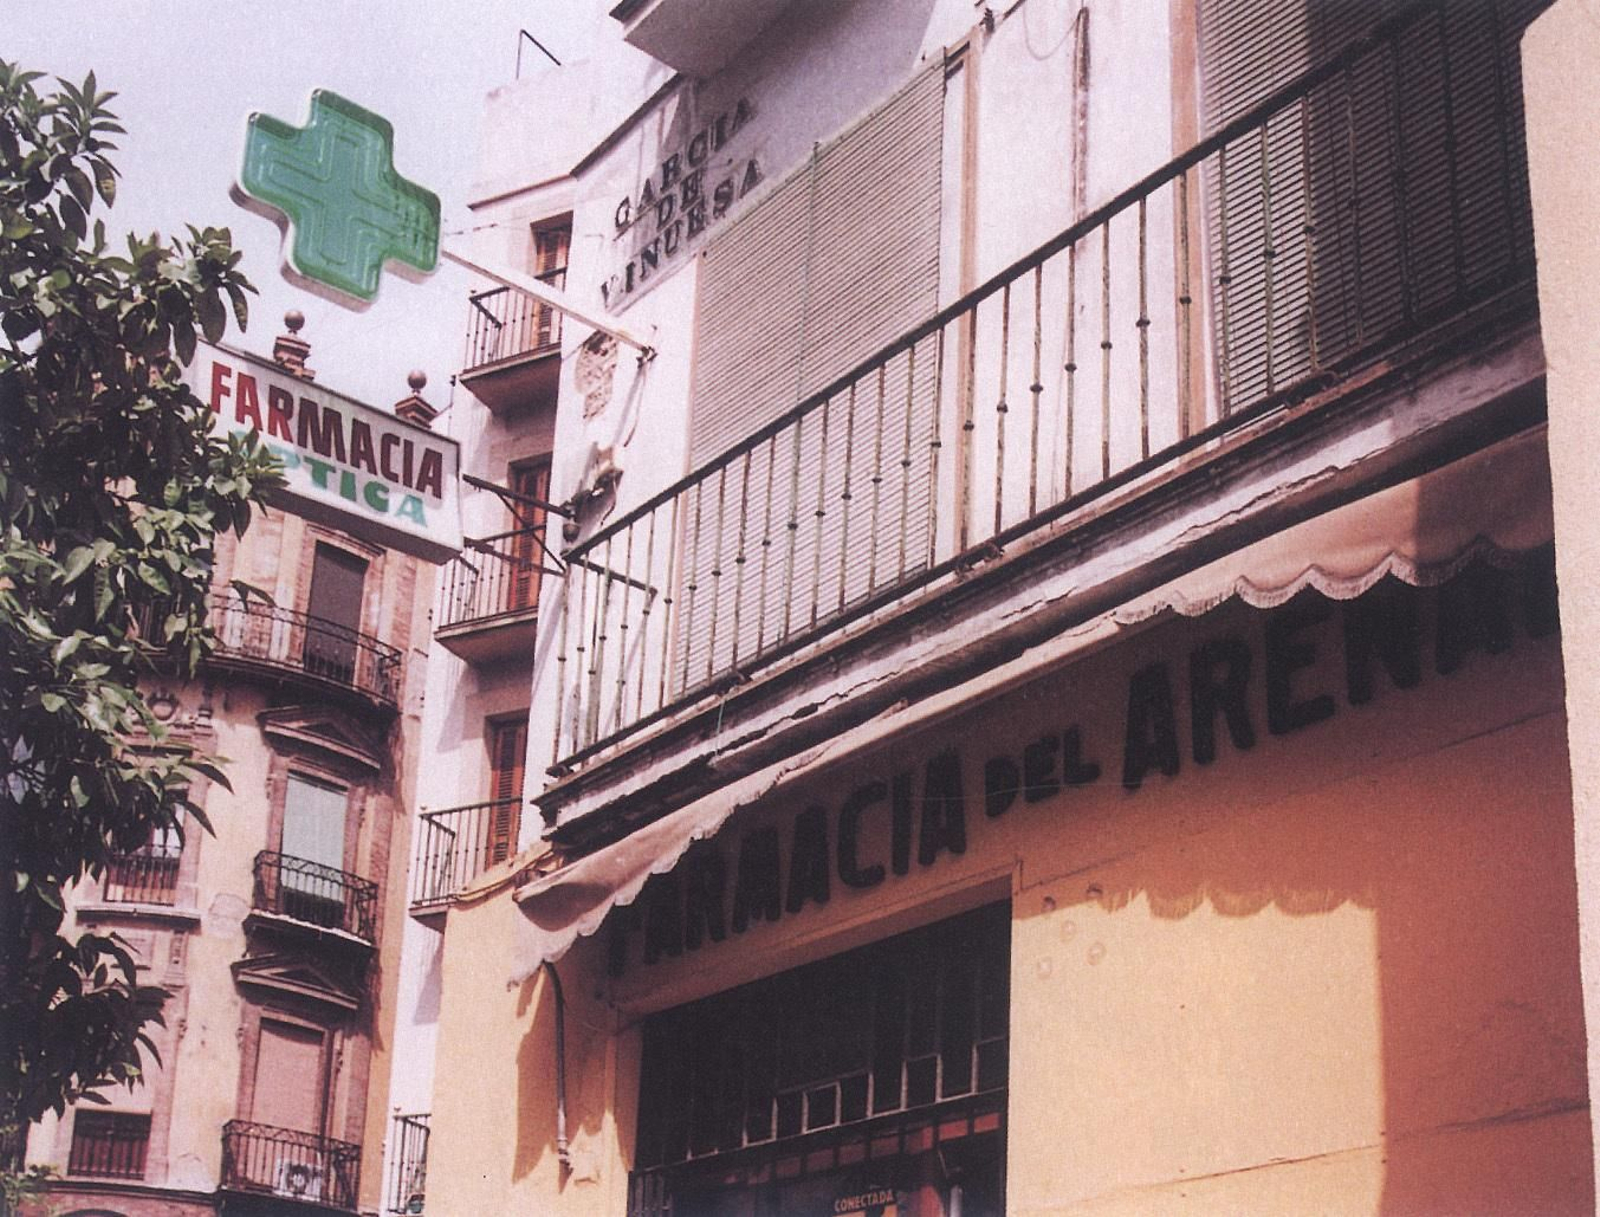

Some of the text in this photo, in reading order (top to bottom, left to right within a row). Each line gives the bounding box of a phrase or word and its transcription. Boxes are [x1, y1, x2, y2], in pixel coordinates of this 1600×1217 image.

[614, 97, 757, 231] GARCIA
[656, 168, 704, 232] DE
[600, 158, 764, 309] VINUESA
[210, 360, 443, 500] FARMACIA
[229, 431, 427, 528] PTICA
[984, 723, 1102, 818] DEL
[834, 1188, 895, 1212] CONECTADA
